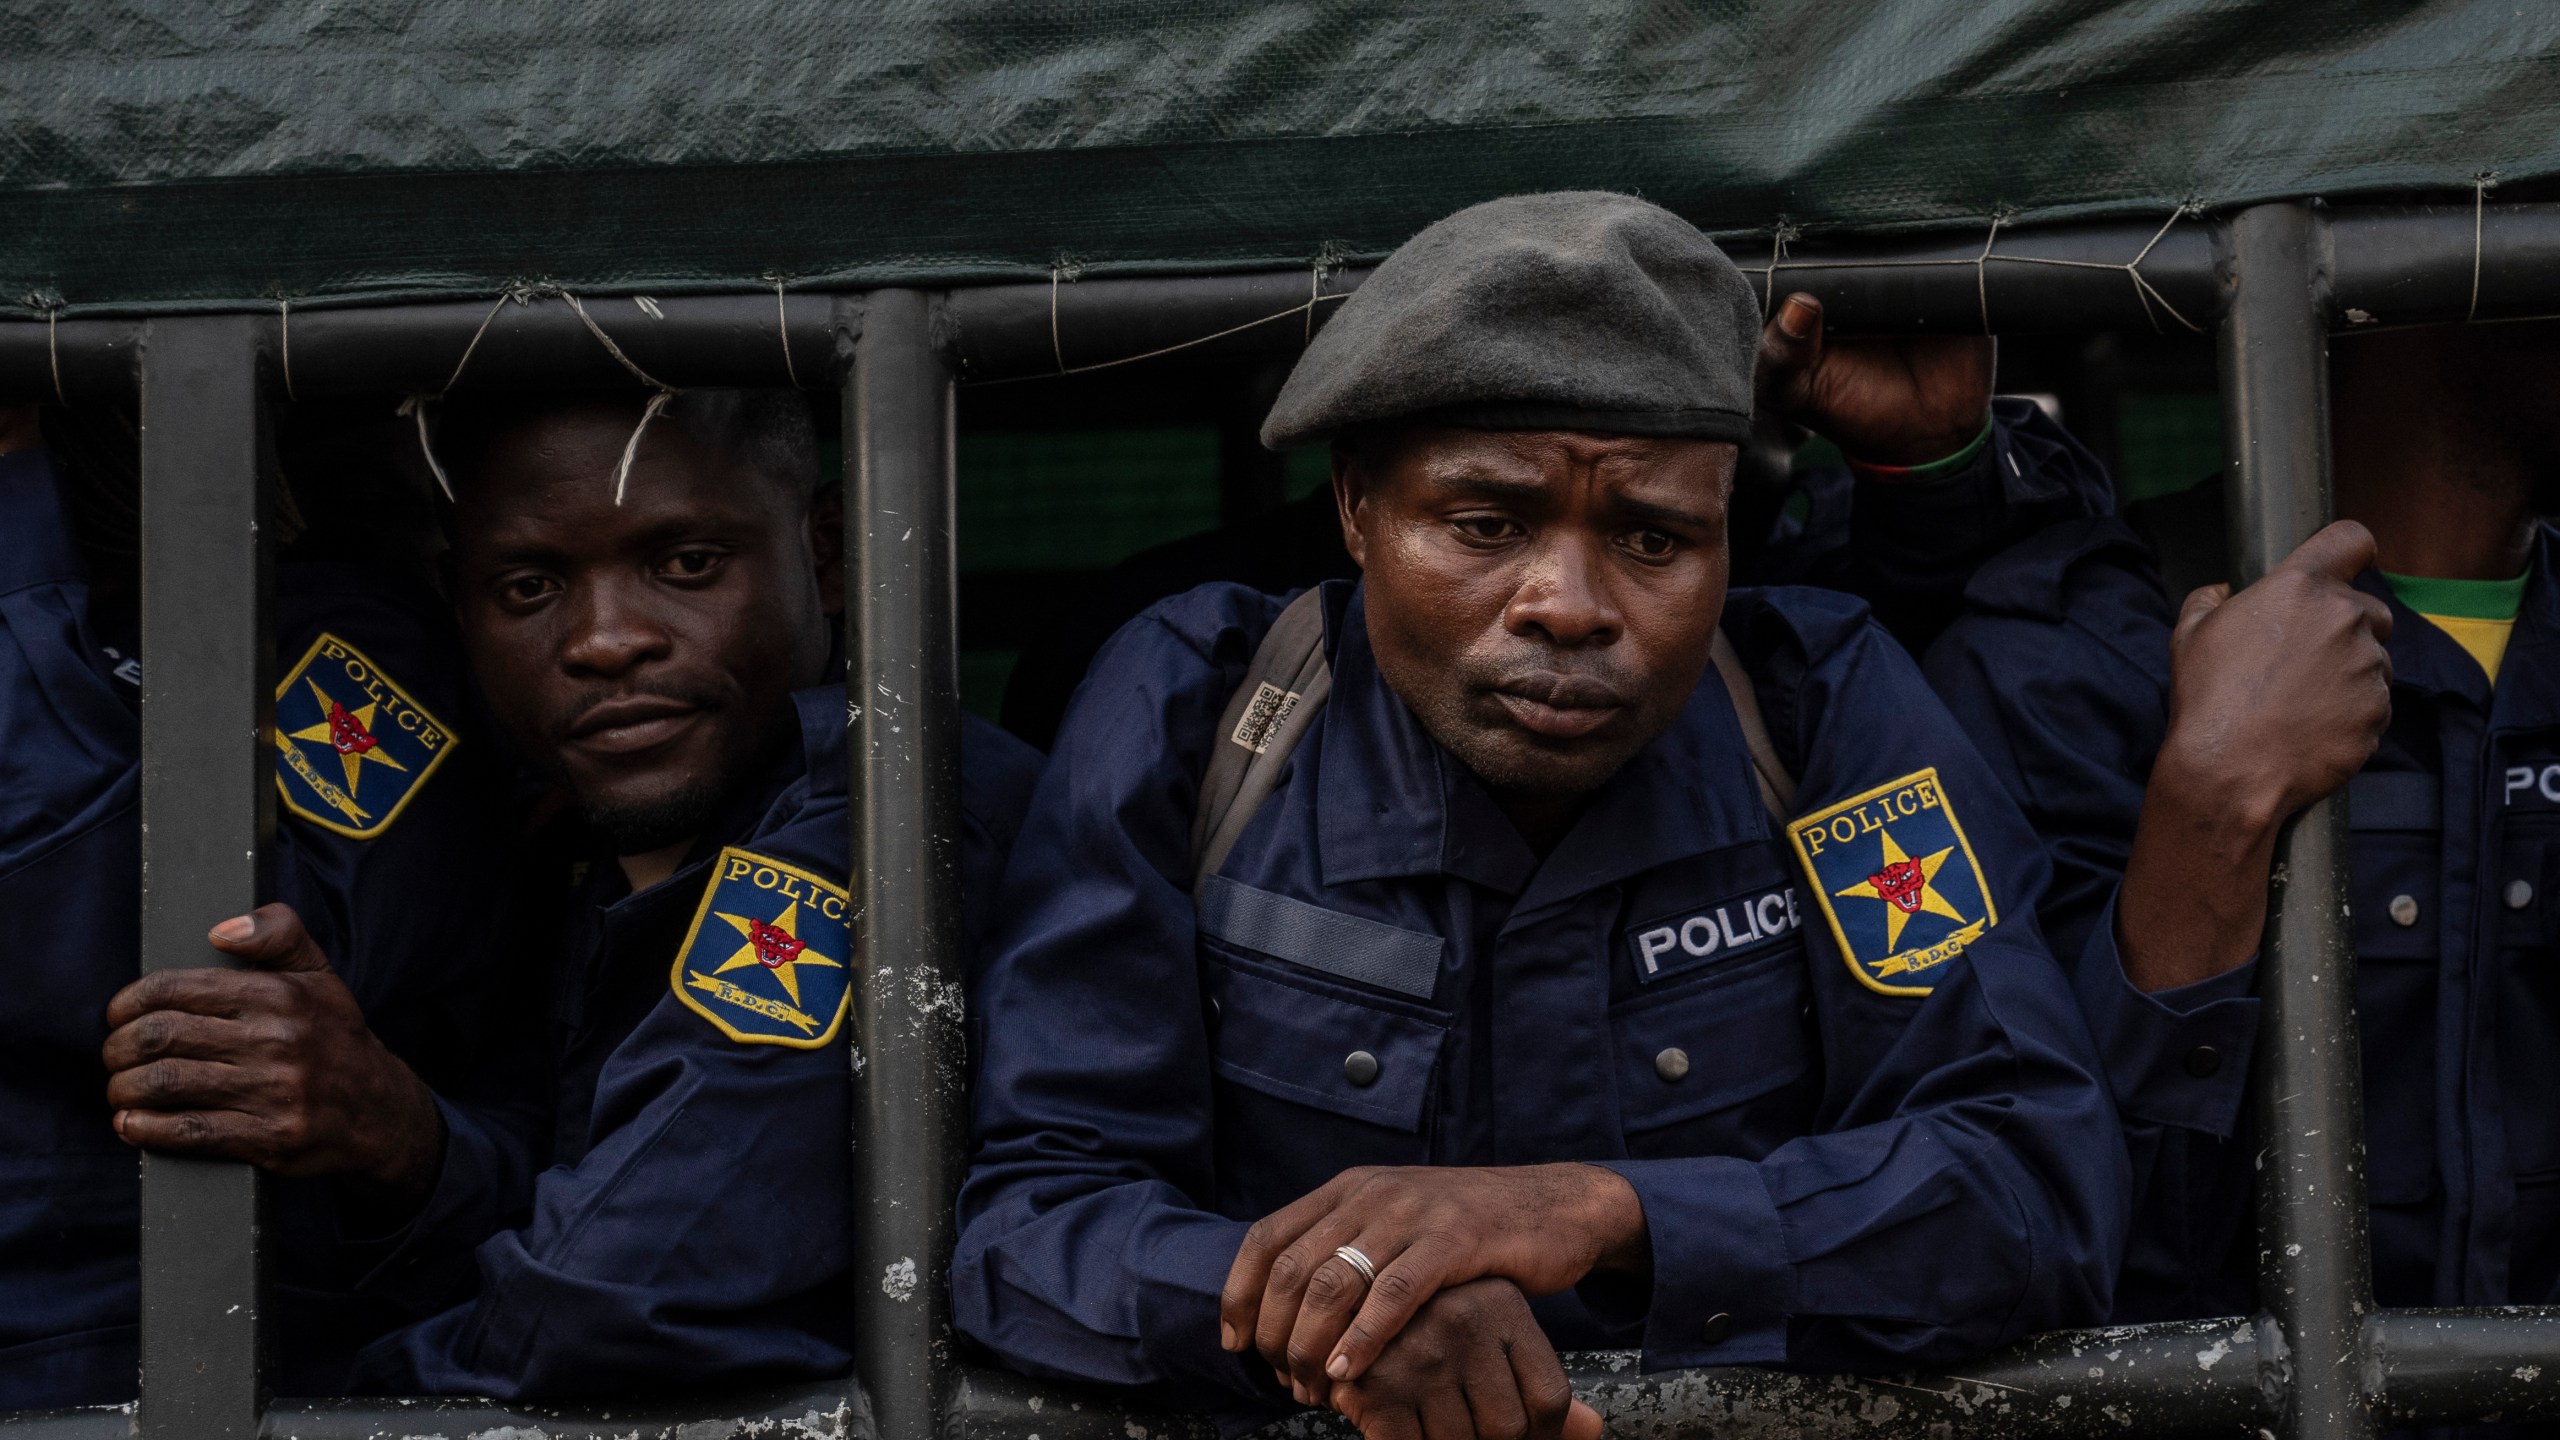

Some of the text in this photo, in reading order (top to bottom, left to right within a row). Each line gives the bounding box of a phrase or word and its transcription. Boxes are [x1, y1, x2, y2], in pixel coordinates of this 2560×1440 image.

[321, 641, 442, 750] POLICE
[1803, 780, 1940, 857] POLICE
[724, 858, 850, 928] POLIC
